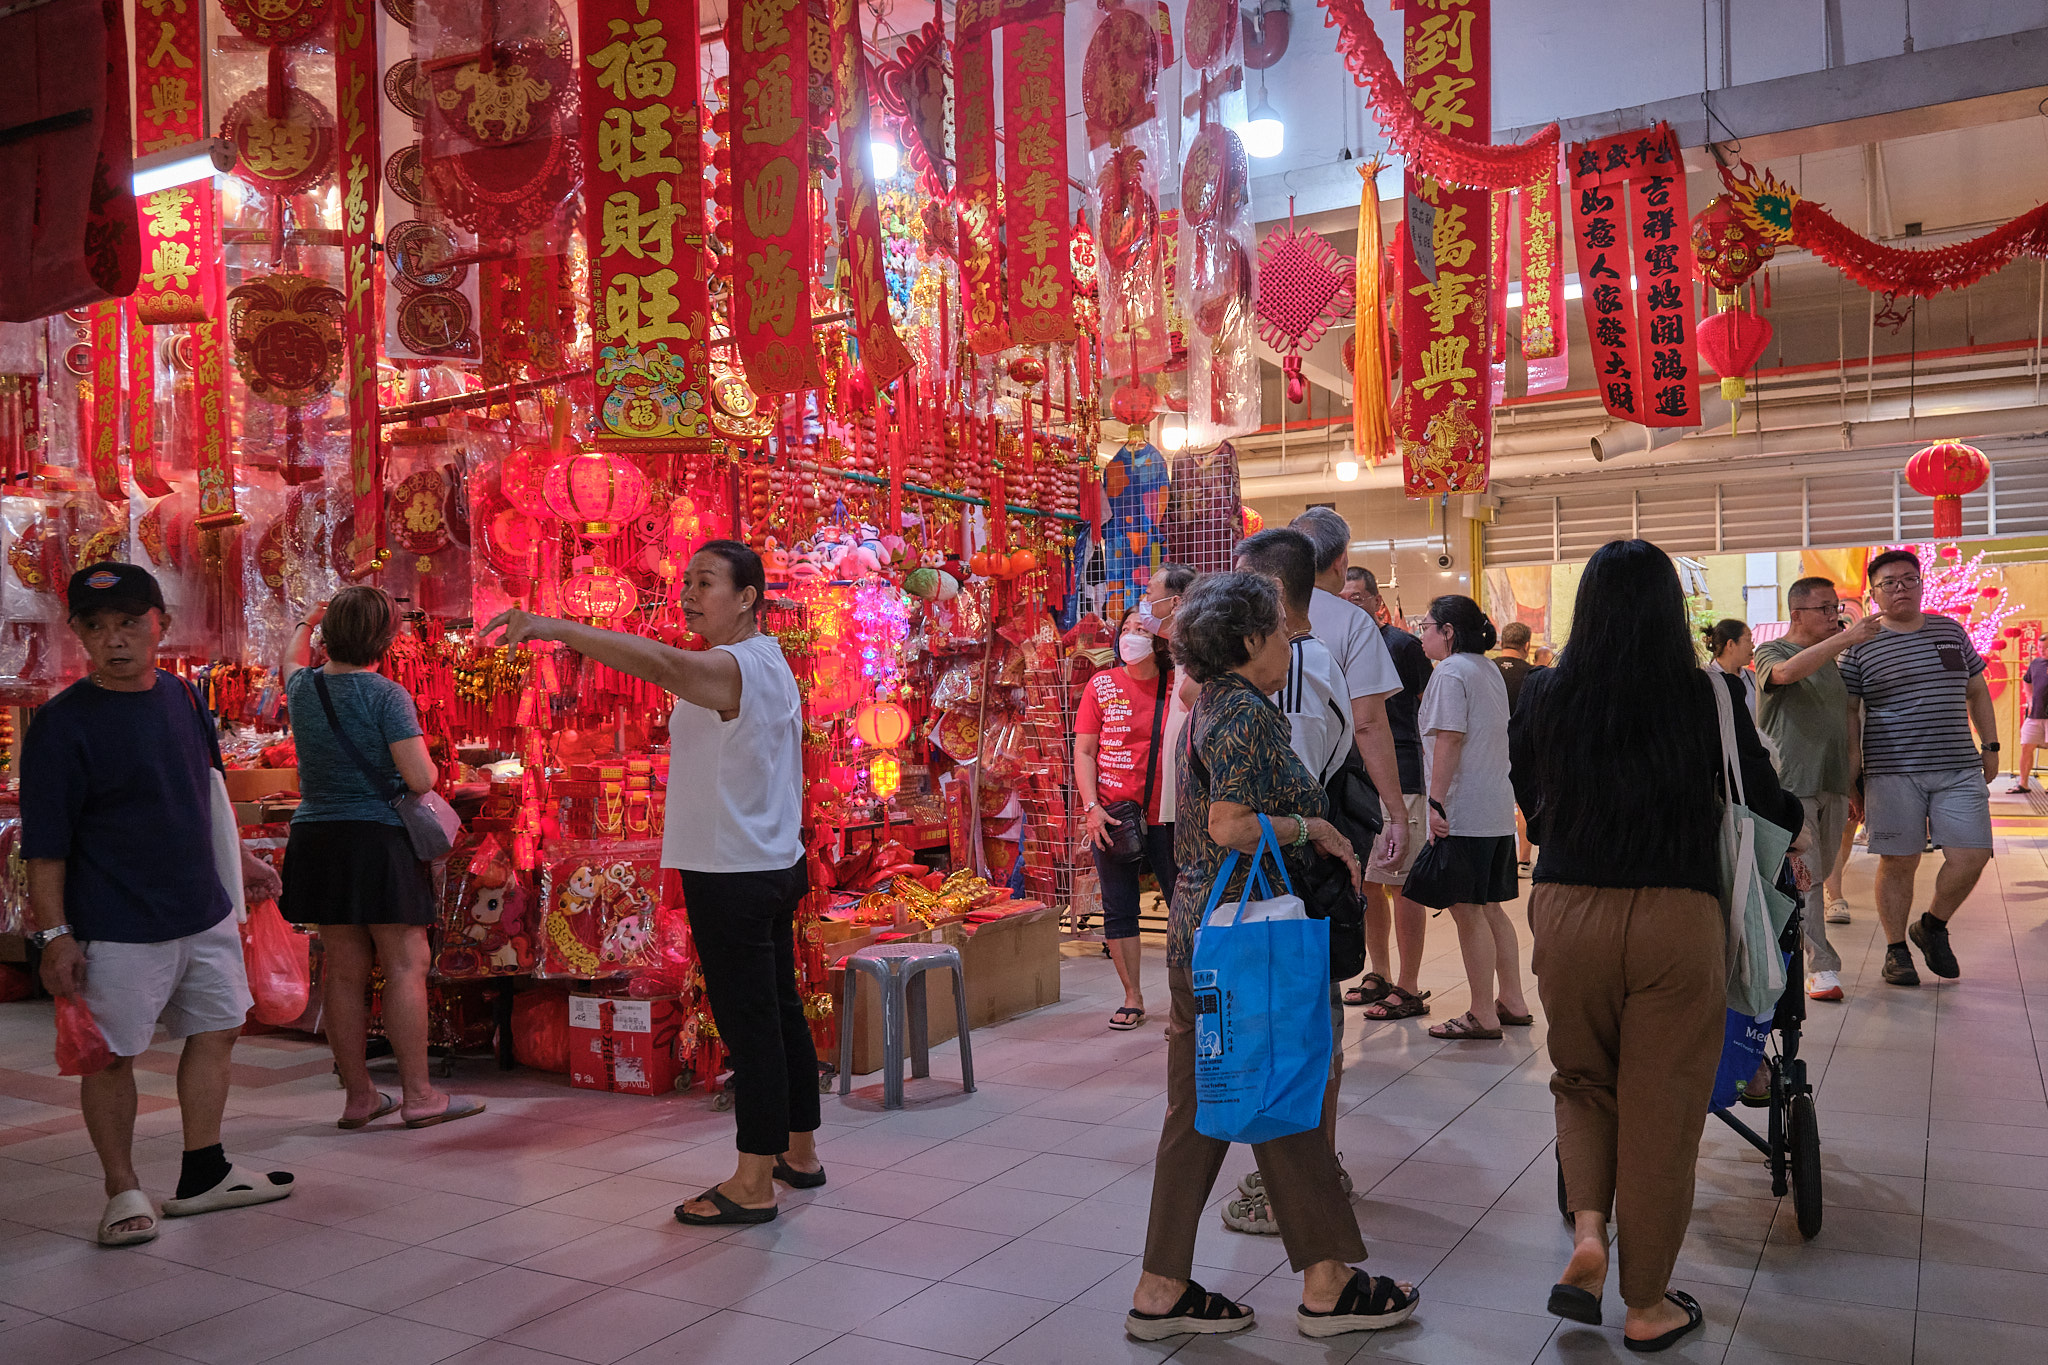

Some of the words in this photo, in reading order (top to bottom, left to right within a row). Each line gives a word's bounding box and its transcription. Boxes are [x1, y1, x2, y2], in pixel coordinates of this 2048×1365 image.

[140, 0, 198, 292] 人興業興
[585, 0, 690, 348] 福旺財旺
[1011, 26, 1063, 308] 意興隆年年好
[1073, 244, 1096, 266] 福
[1408, 0, 1477, 401] 到家萬事興
[1724, 223, 1744, 240] 福
[723, 383, 749, 412] 福
[1581, 187, 1635, 414] 如意人家發大財
[1640, 175, 1690, 416] 吉祥寶地開鴻運
[404, 491, 440, 532] 福
[630, 399, 657, 426] 福
